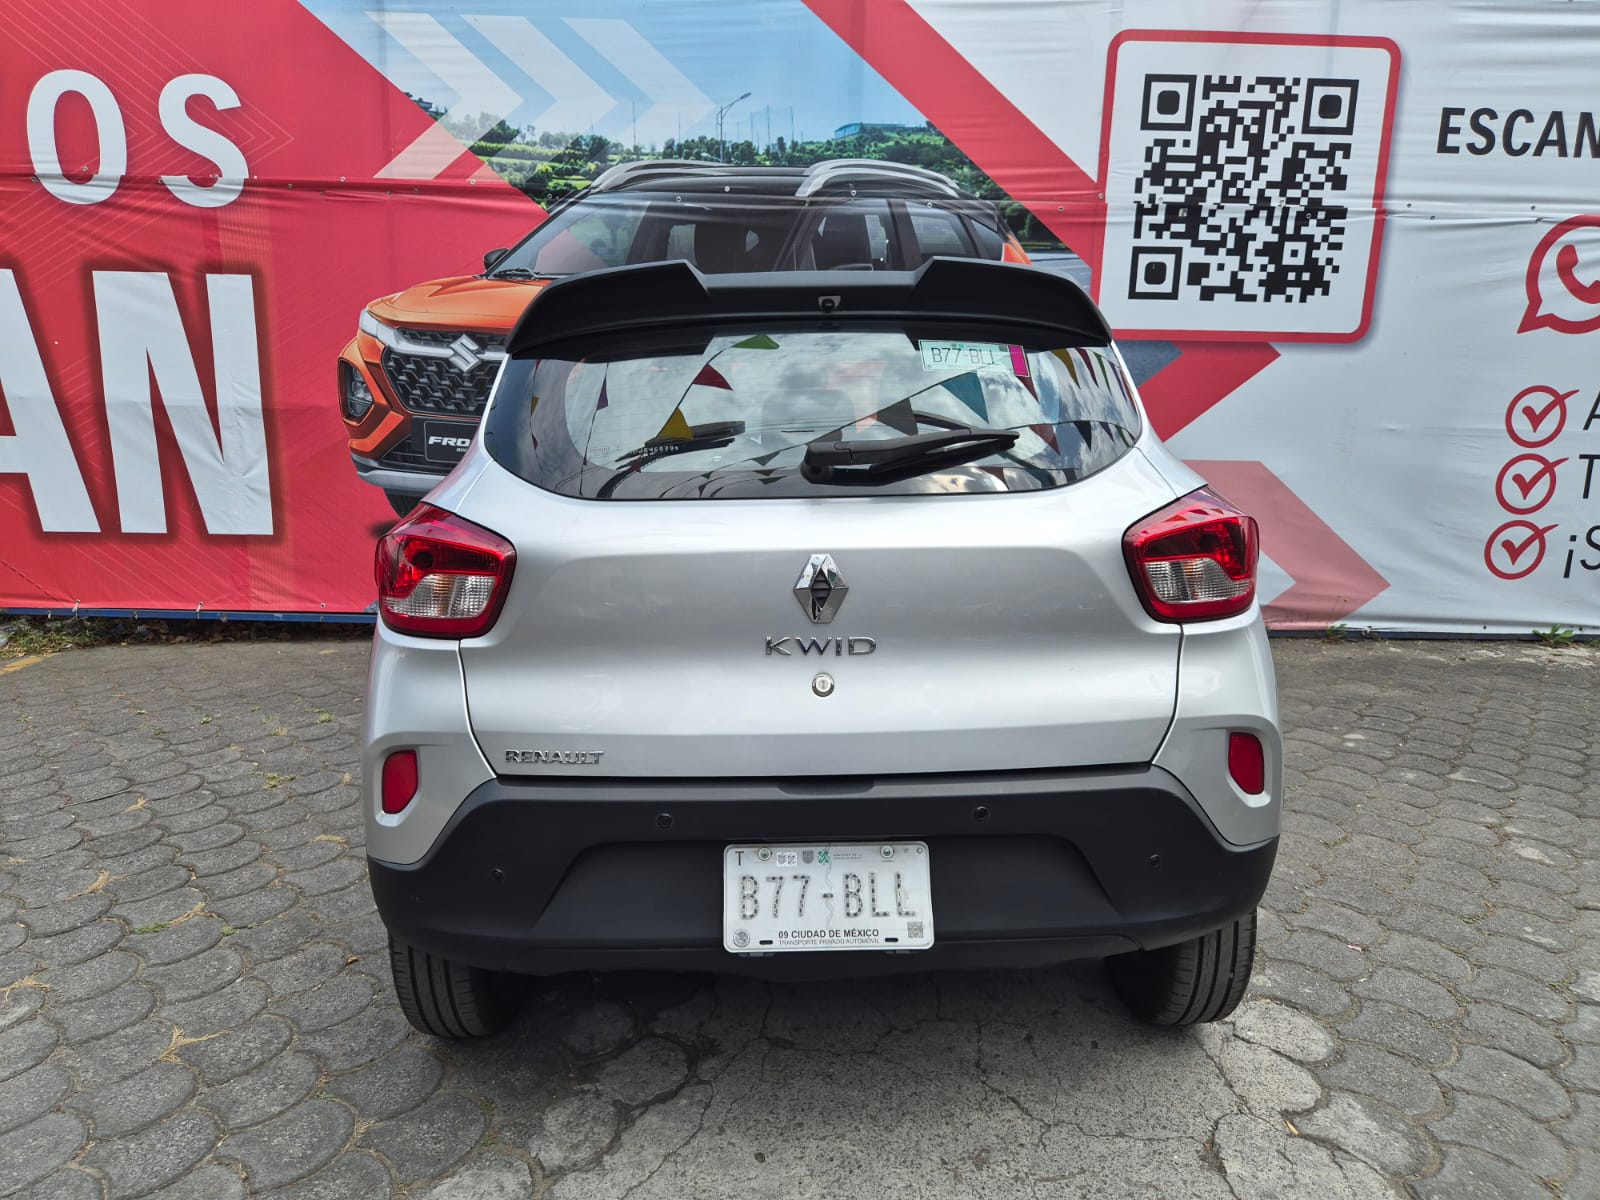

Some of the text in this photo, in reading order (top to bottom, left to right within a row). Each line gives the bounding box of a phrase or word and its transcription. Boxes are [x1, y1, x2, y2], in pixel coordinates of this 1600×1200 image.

[26, 69, 250, 208] OS
[1436, 107, 1600, 159] ESCAN
[765, 636, 877, 656] KWID
[504, 749, 605, 765] RENAULT
[735, 851, 744, 866] T
[741, 872, 916, 920] B77-BLL
[778, 928, 879, 939] 09 CIUDAD DE MÉXICO
